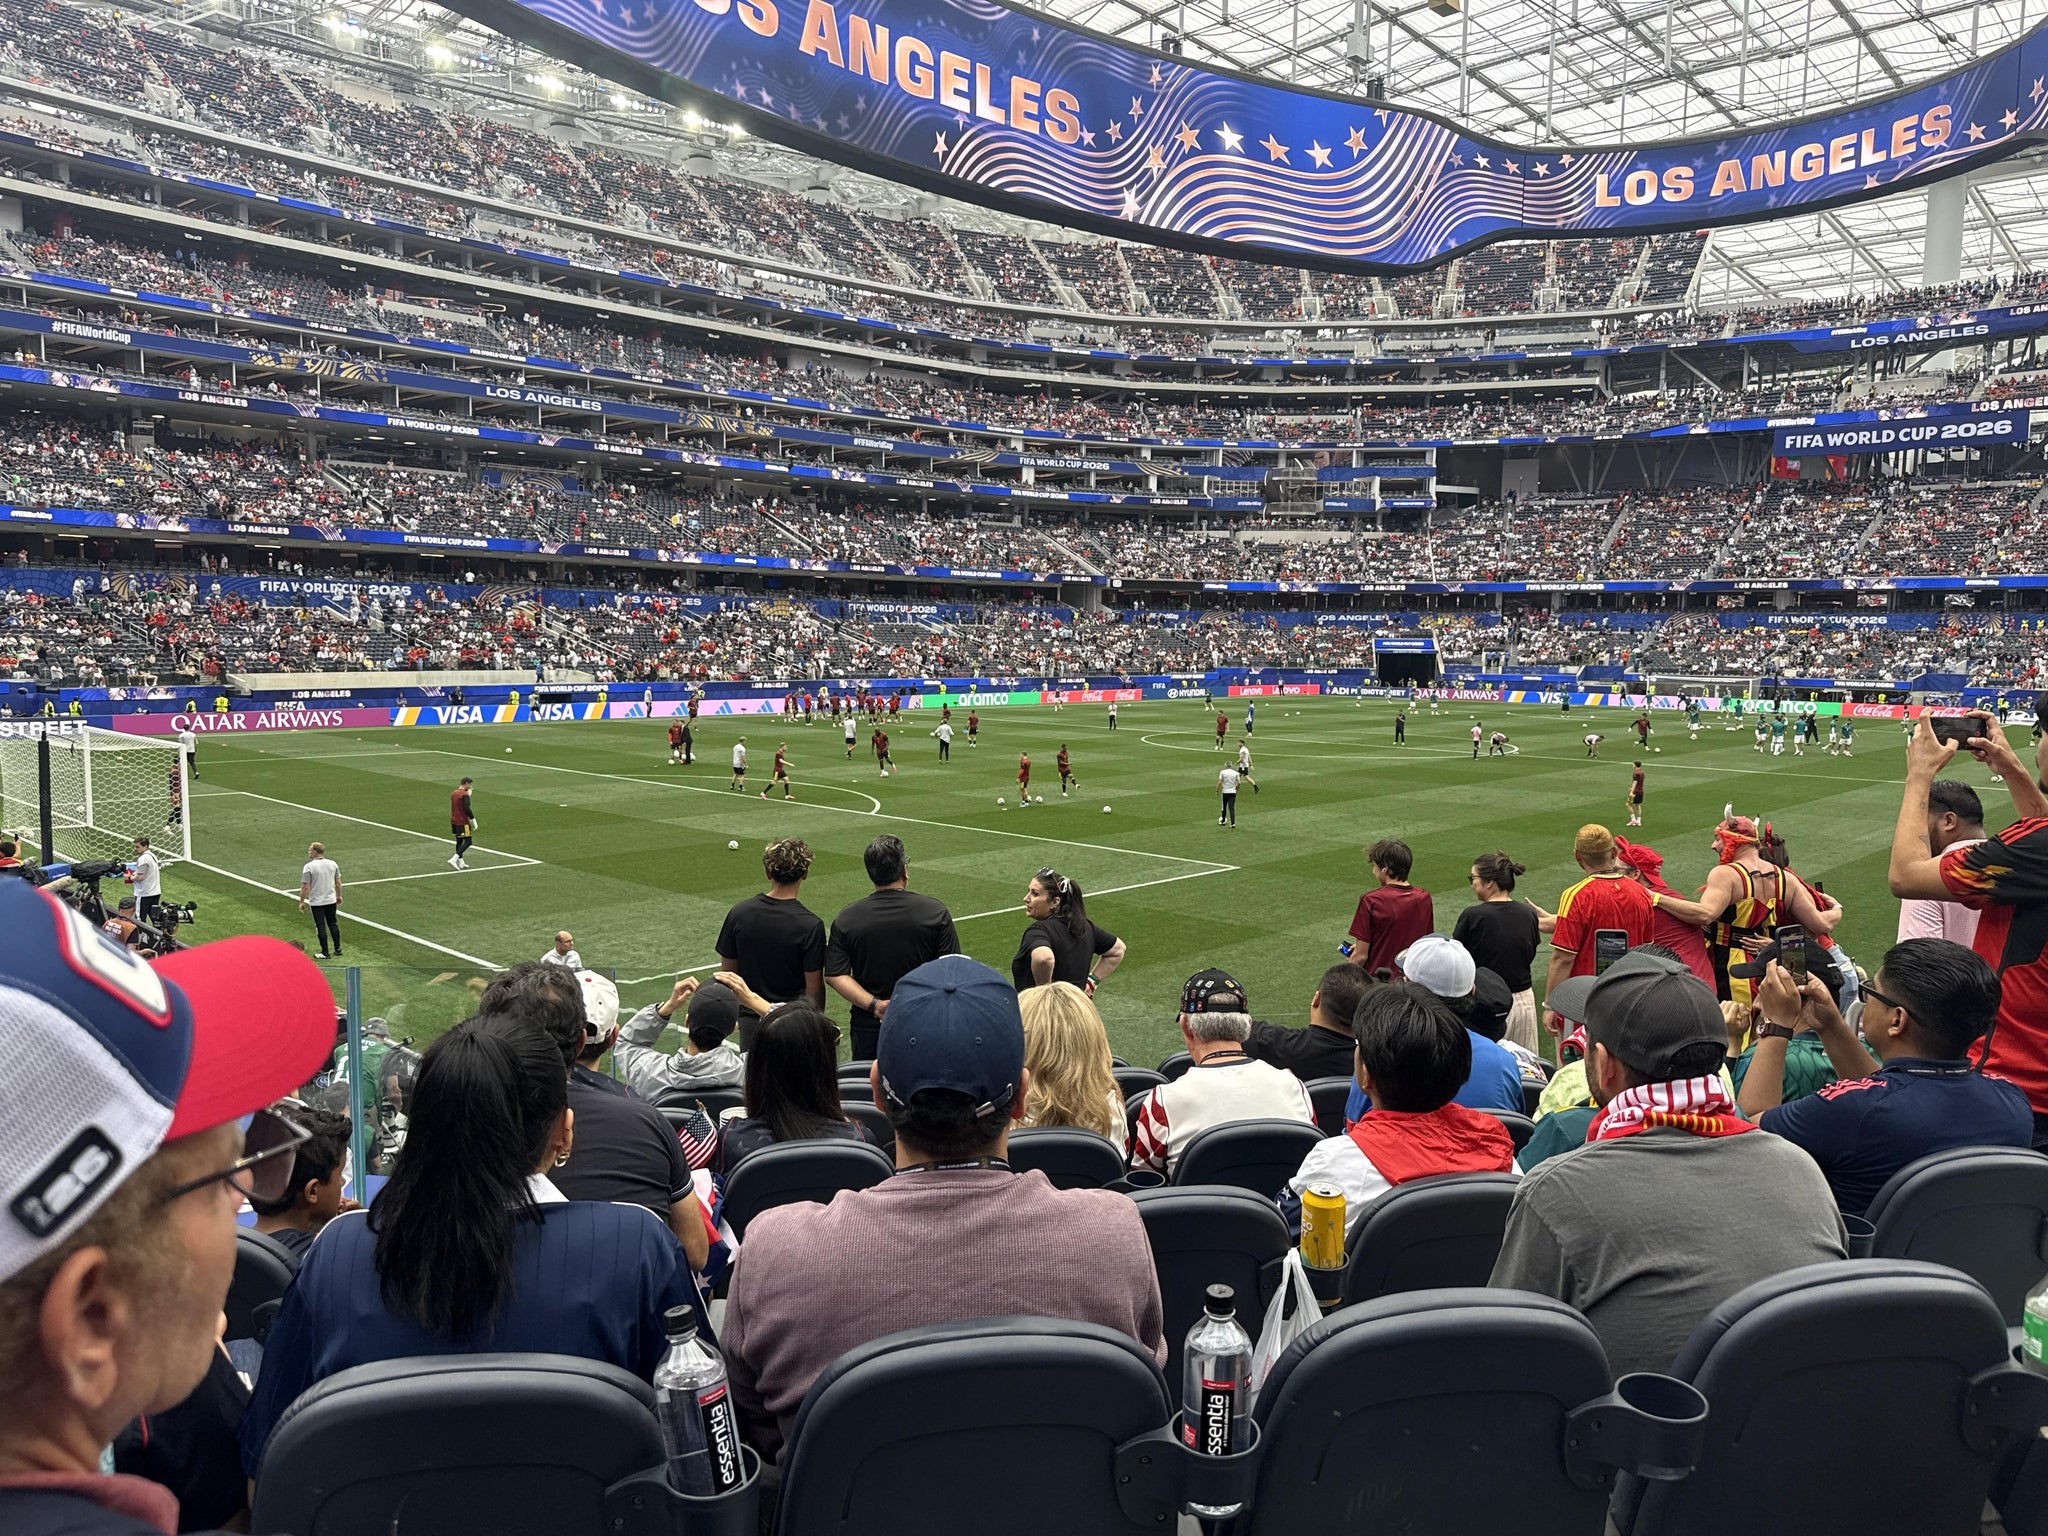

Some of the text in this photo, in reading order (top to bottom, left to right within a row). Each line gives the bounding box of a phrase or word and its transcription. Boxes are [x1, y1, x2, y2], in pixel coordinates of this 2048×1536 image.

[798, 0, 1081, 145] ANGELES
[1594, 104, 1953, 208] LOS ANGELES
[2010, 306, 2031, 316] LOS
[306, 321, 319, 329] LOS
[52, 321, 132, 345] #FIFAWorldCup
[1851, 325, 1989, 348] LOS ANGELES
[178, 391, 248, 407] LOS ANGELES
[486, 386, 602, 411] LOS ANGELES
[1971, 401, 2000, 412] LOS
[387, 418, 405, 427] FIFA
[406, 420, 435, 430] WORLD
[436, 423, 451, 432] CUP
[1785, 420, 2013, 449] FIFA WORLD CUP 2026
[1020, 457, 1110, 470] FIFA WORLD CUP 2026
[228, 524, 290, 535] LOS ANGELES
[260, 581, 290, 592] FIFA
[867, 605, 894, 613] WORLD
[1331, 687, 1350, 695] ADI
[1452, 690, 1500, 700] AIRWAYS
[1536, 691, 1565, 704] VIS
[959, 693, 1009, 706] aramco
[171, 710, 344, 732] QATAR AIRWAYS
[431, 705, 483, 724] VISA
[1207, 1393, 1224, 1456] ssentia
[710, 1403, 735, 1485] essentia
